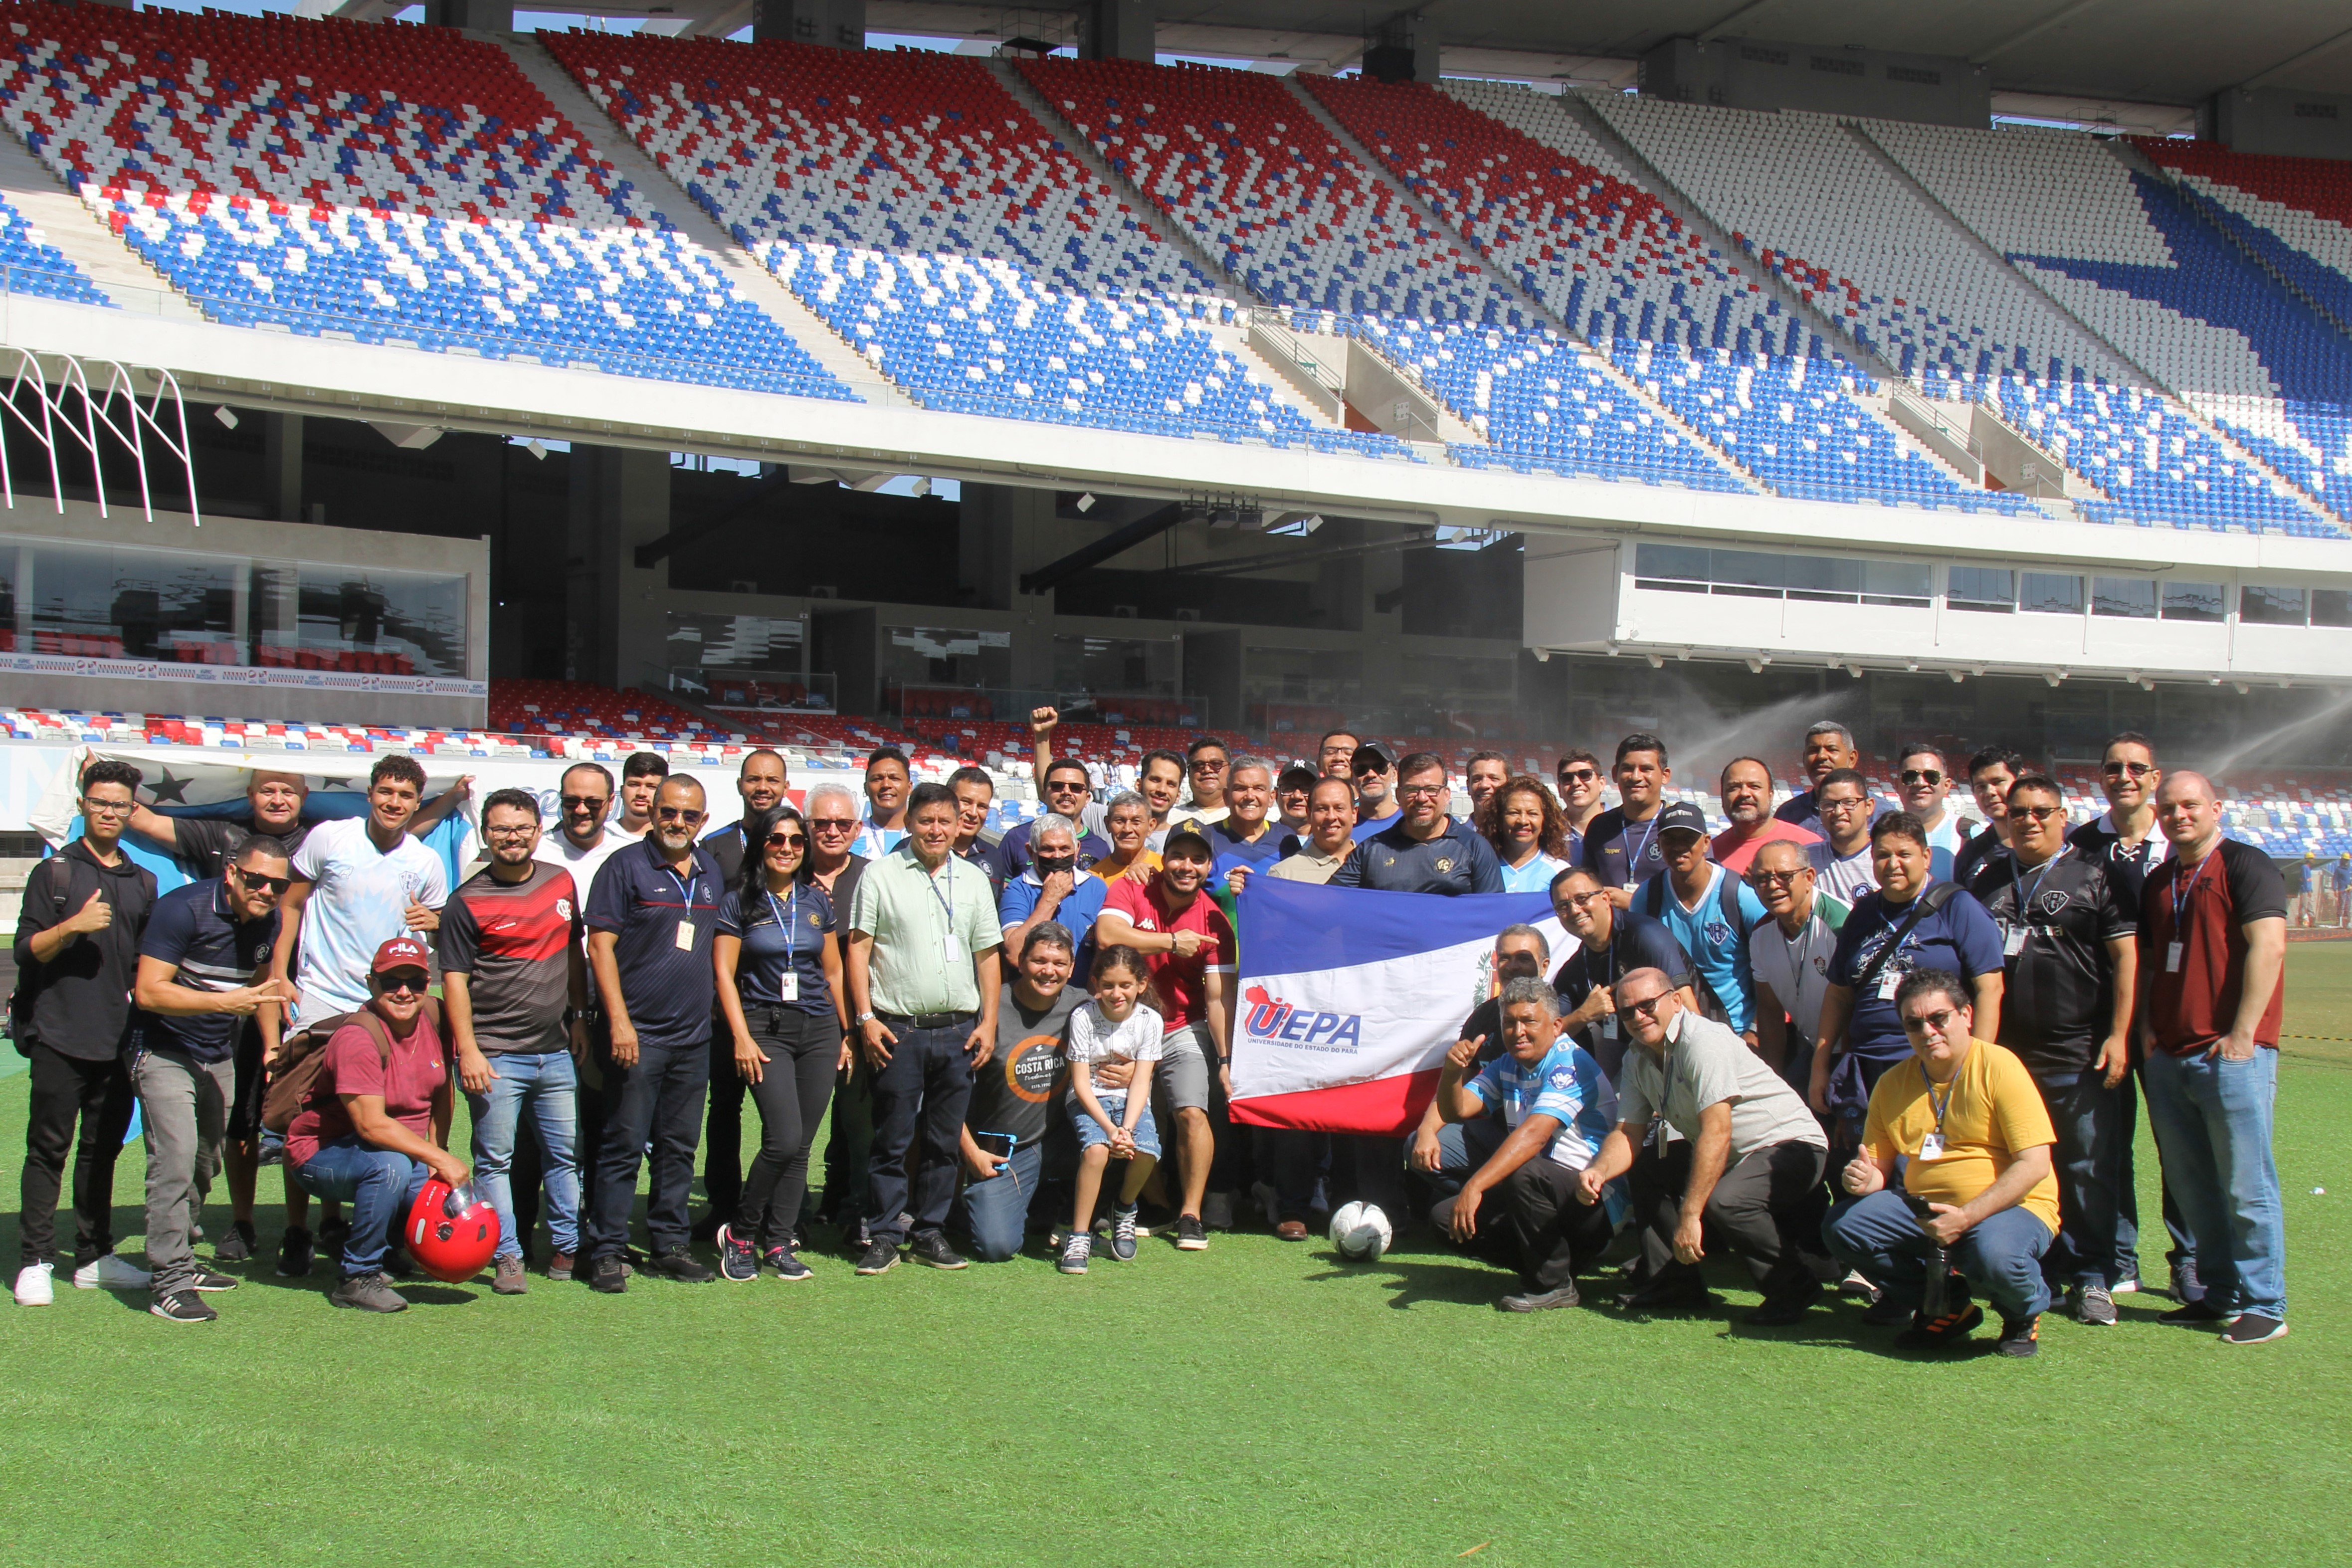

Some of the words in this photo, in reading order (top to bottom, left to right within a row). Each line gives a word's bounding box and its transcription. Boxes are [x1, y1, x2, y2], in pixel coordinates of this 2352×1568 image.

[1293, 759, 1306, 768] NY
[389, 942, 419, 954] FILA
[1248, 1003, 1361, 1046] UEPA
[1247, 1038, 1293, 1048] UNIVERSIDADE
[1015, 1061, 1043, 1075] COSTA
[1044, 1056, 1065, 1070] RICA
